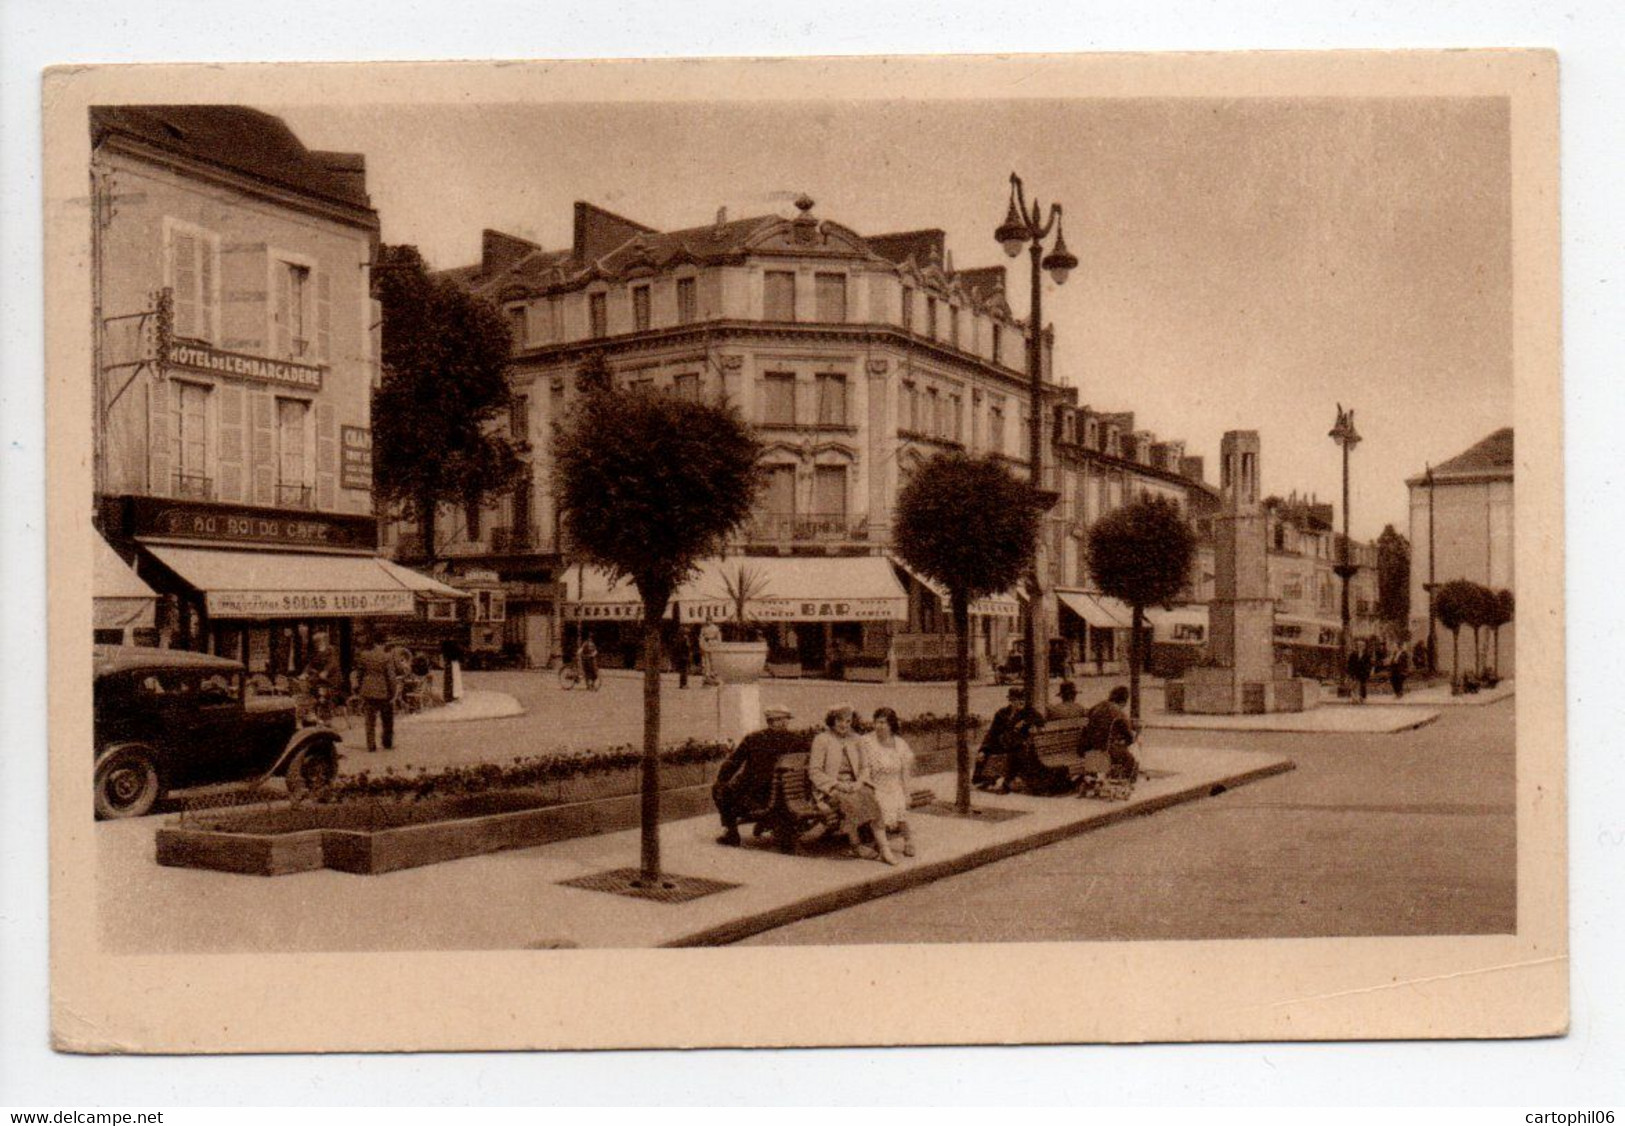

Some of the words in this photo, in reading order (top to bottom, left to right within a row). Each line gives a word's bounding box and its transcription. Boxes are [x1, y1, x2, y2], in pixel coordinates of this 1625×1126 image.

[228, 518, 254, 536] ROI
[282, 595, 327, 610] SODAS
[334, 595, 368, 610] LUDO
[801, 603, 851, 616] BAR
